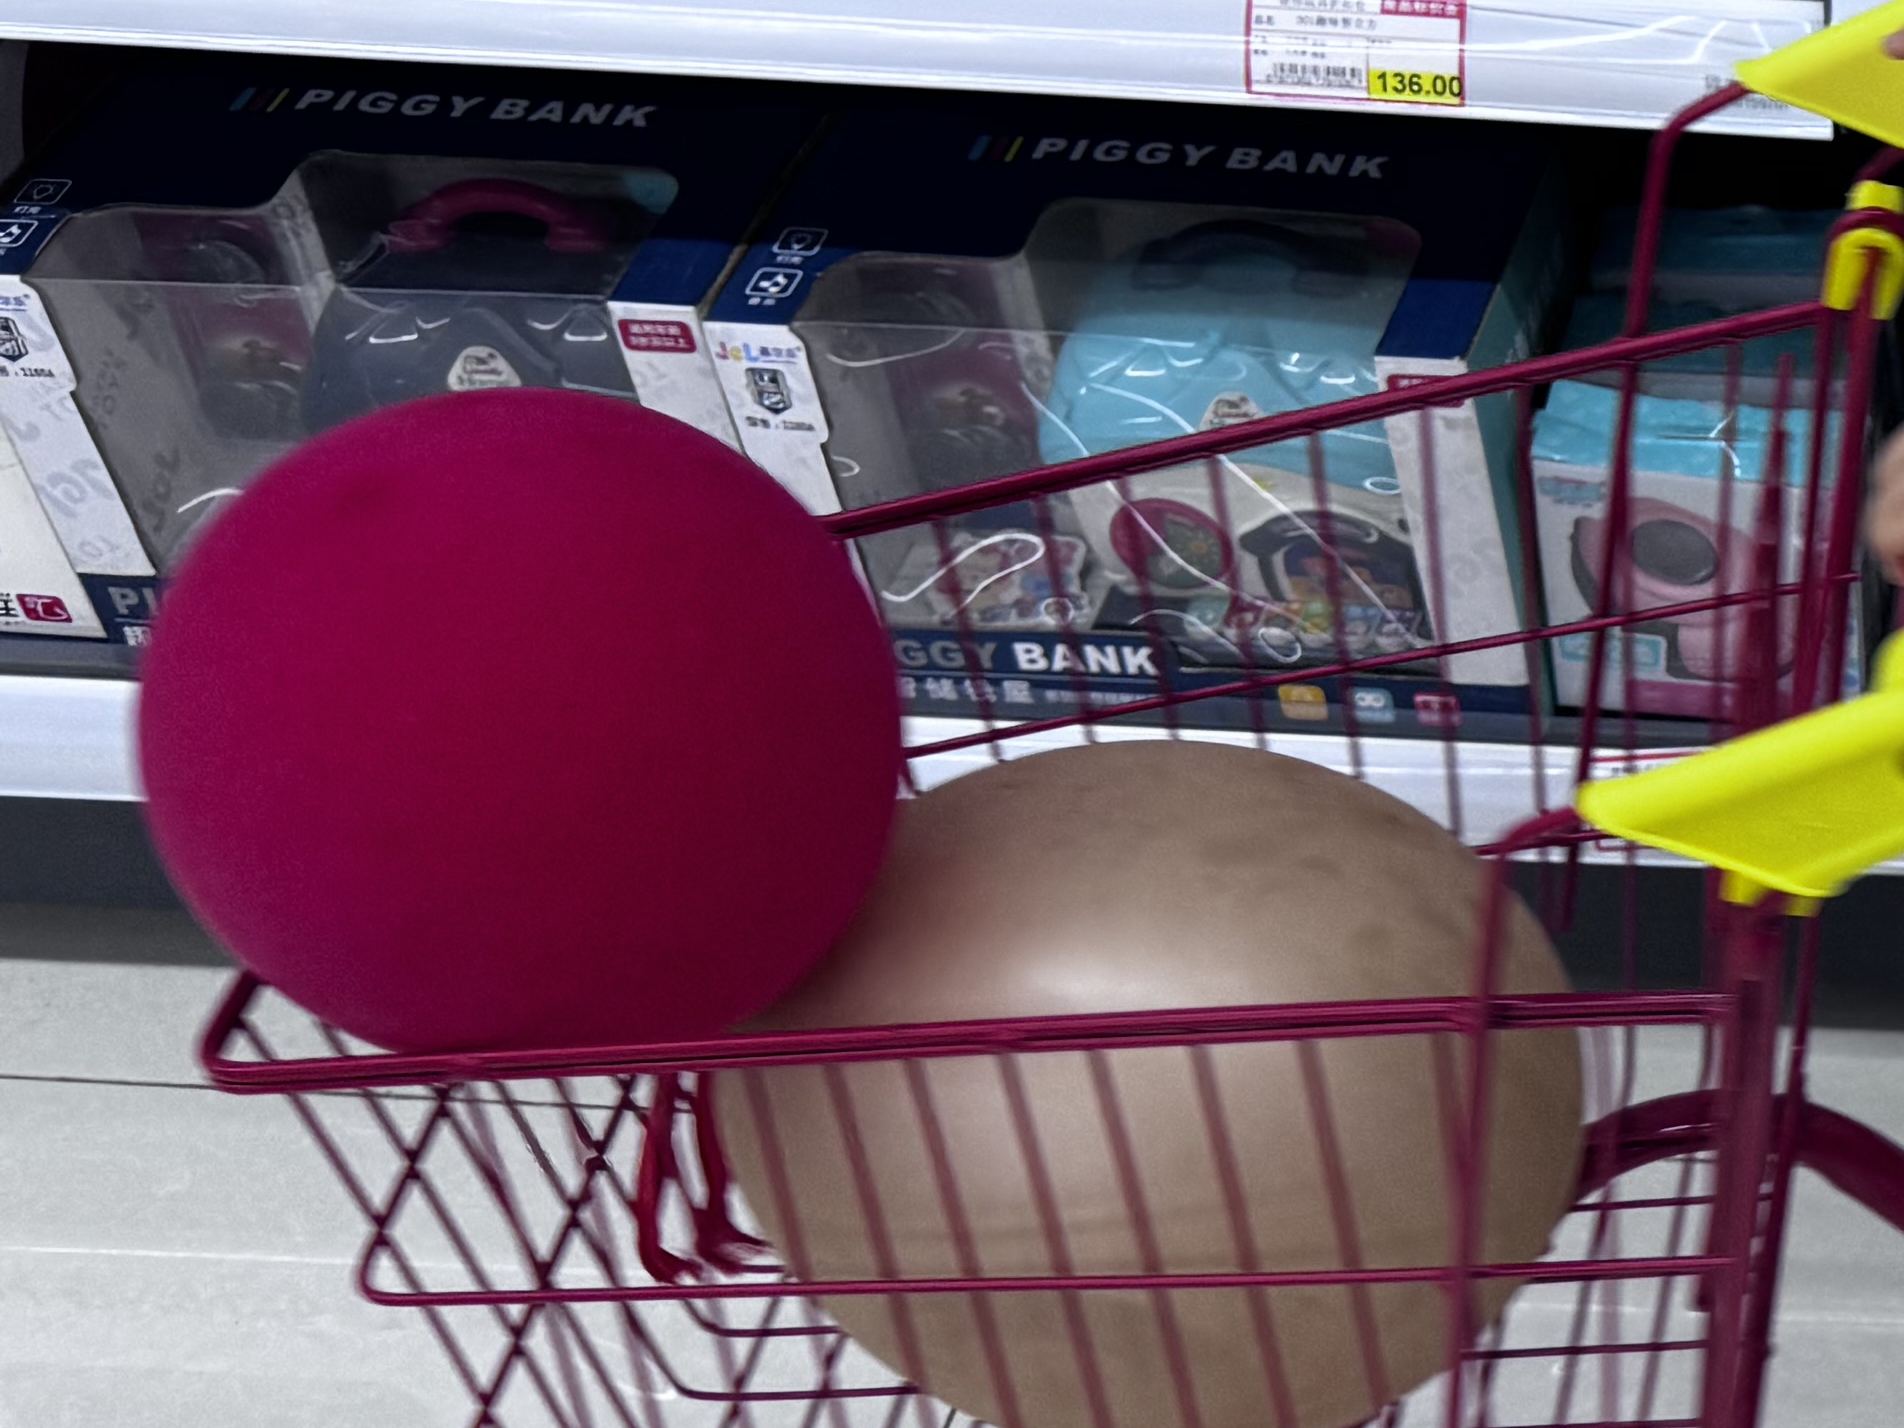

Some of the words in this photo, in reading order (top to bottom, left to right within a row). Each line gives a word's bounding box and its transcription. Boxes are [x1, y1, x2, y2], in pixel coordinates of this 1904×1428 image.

[1377, 71, 1464, 98] 136.00
[294, 88, 489, 121] PIGGY
[490, 95, 659, 128] BANK
[1031, 136, 1218, 167] PIGGY
[1225, 146, 1391, 179] BANK
